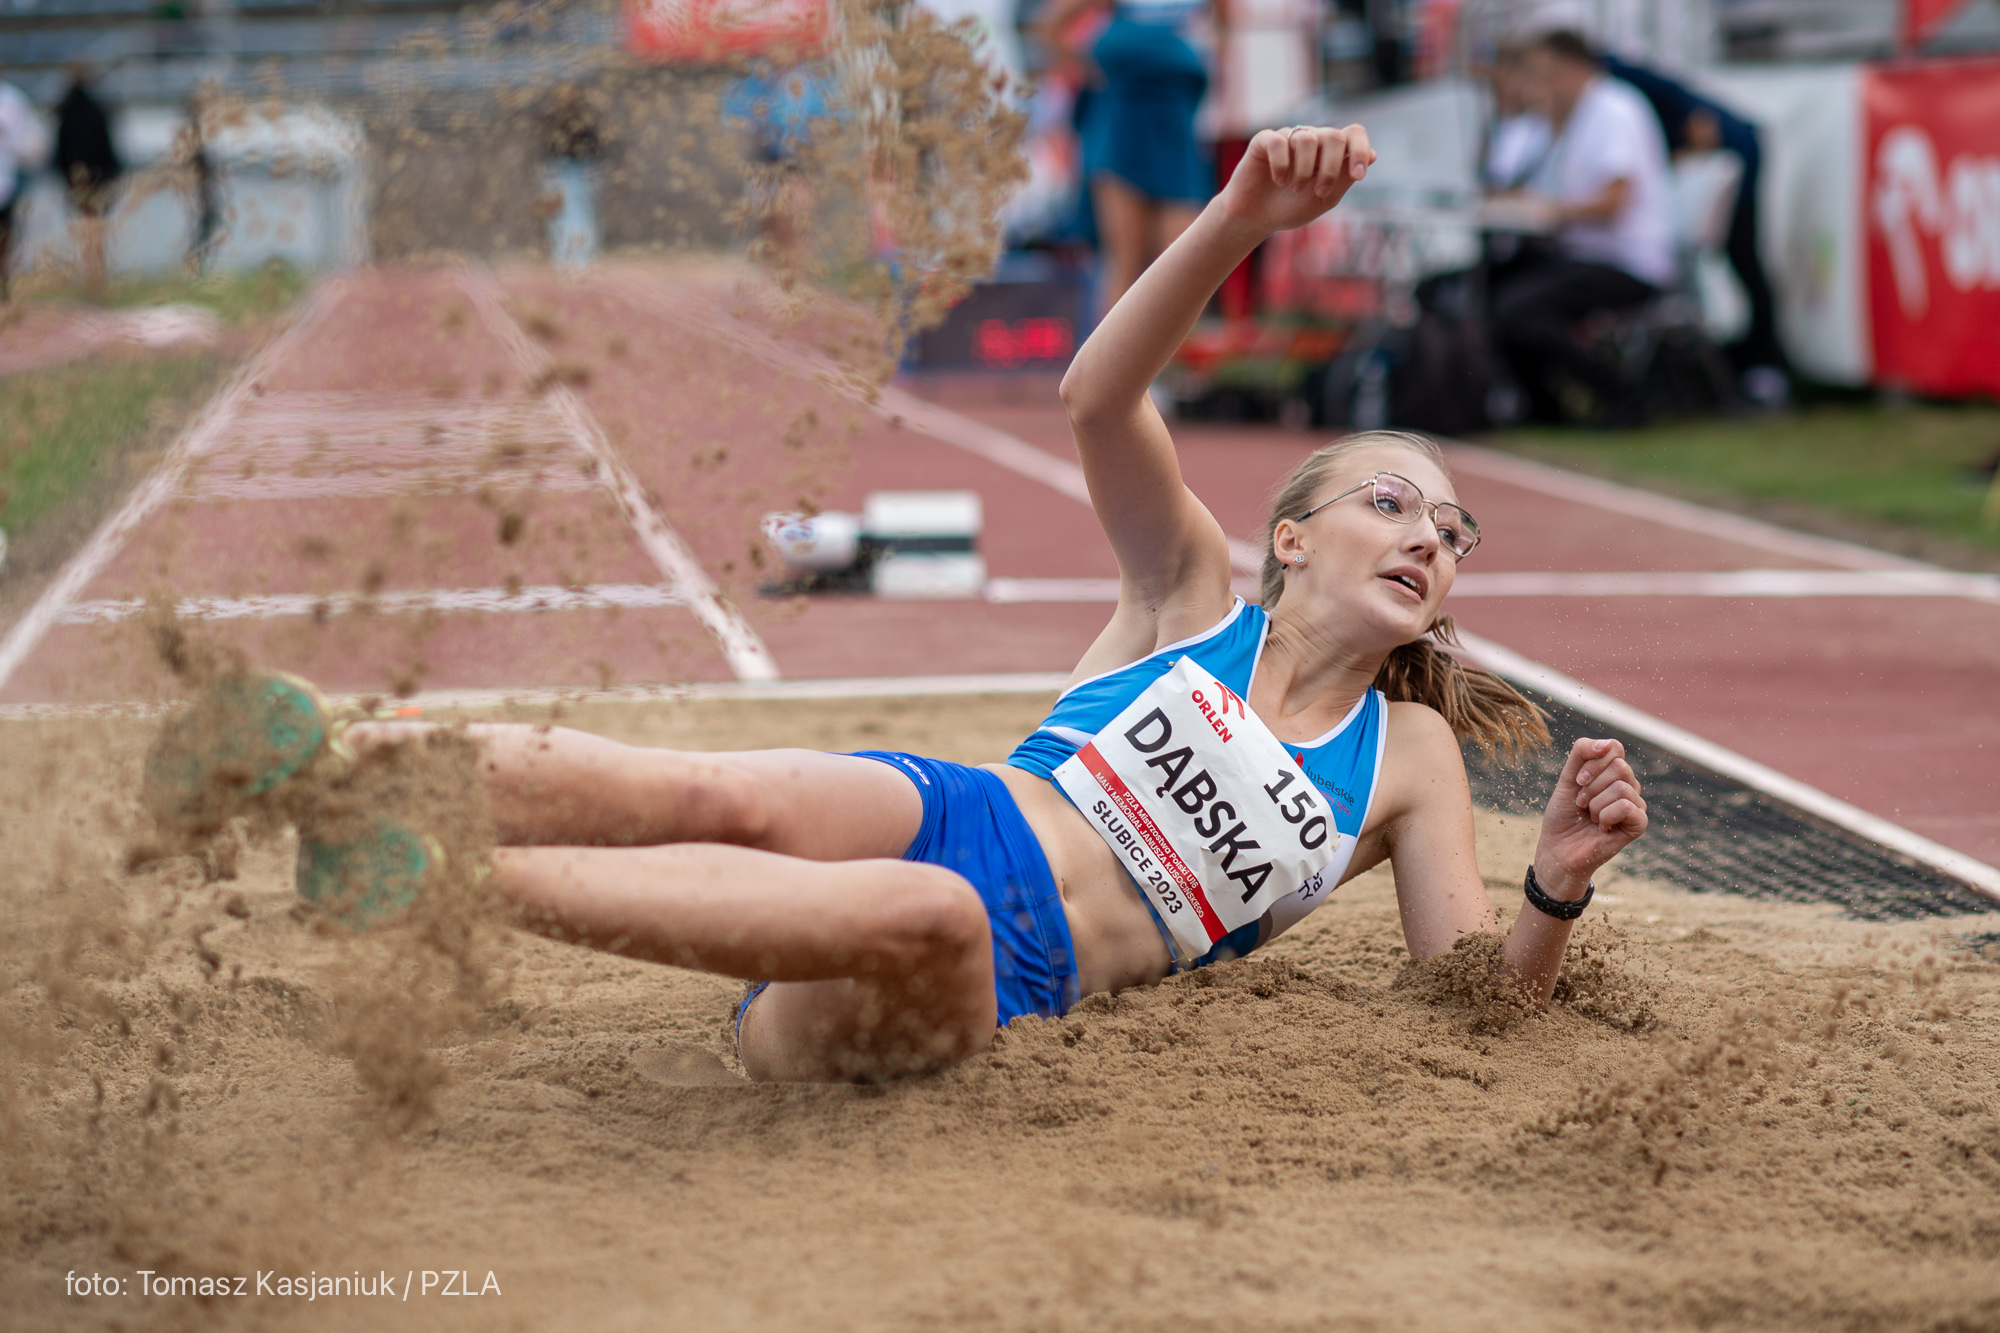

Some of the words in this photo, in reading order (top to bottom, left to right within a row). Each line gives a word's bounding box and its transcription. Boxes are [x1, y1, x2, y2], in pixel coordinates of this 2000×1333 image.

[1191, 689, 1233, 744] ORLEN
[1123, 706, 1274, 904] DĄBSKA
[1263, 768, 1328, 850] 150
[1306, 765, 1355, 807] lubelskie
[1092, 799, 1154, 873] SŁUBICE
[1147, 870, 1183, 915] 2023
[1094, 771, 1115, 793] MAŁY
[1110, 790, 1143, 831] MEMORIAŁ
[1139, 829, 1166, 865] JANUSZA
[1164, 861, 1205, 919] KUSOCIŃSKIEGO
[1122, 791, 1140, 812] PZLA
[1136, 808, 1172, 855] Mistrzostwa
[1169, 852, 1190, 877] Polski
[1186, 873, 1199, 889] U16
